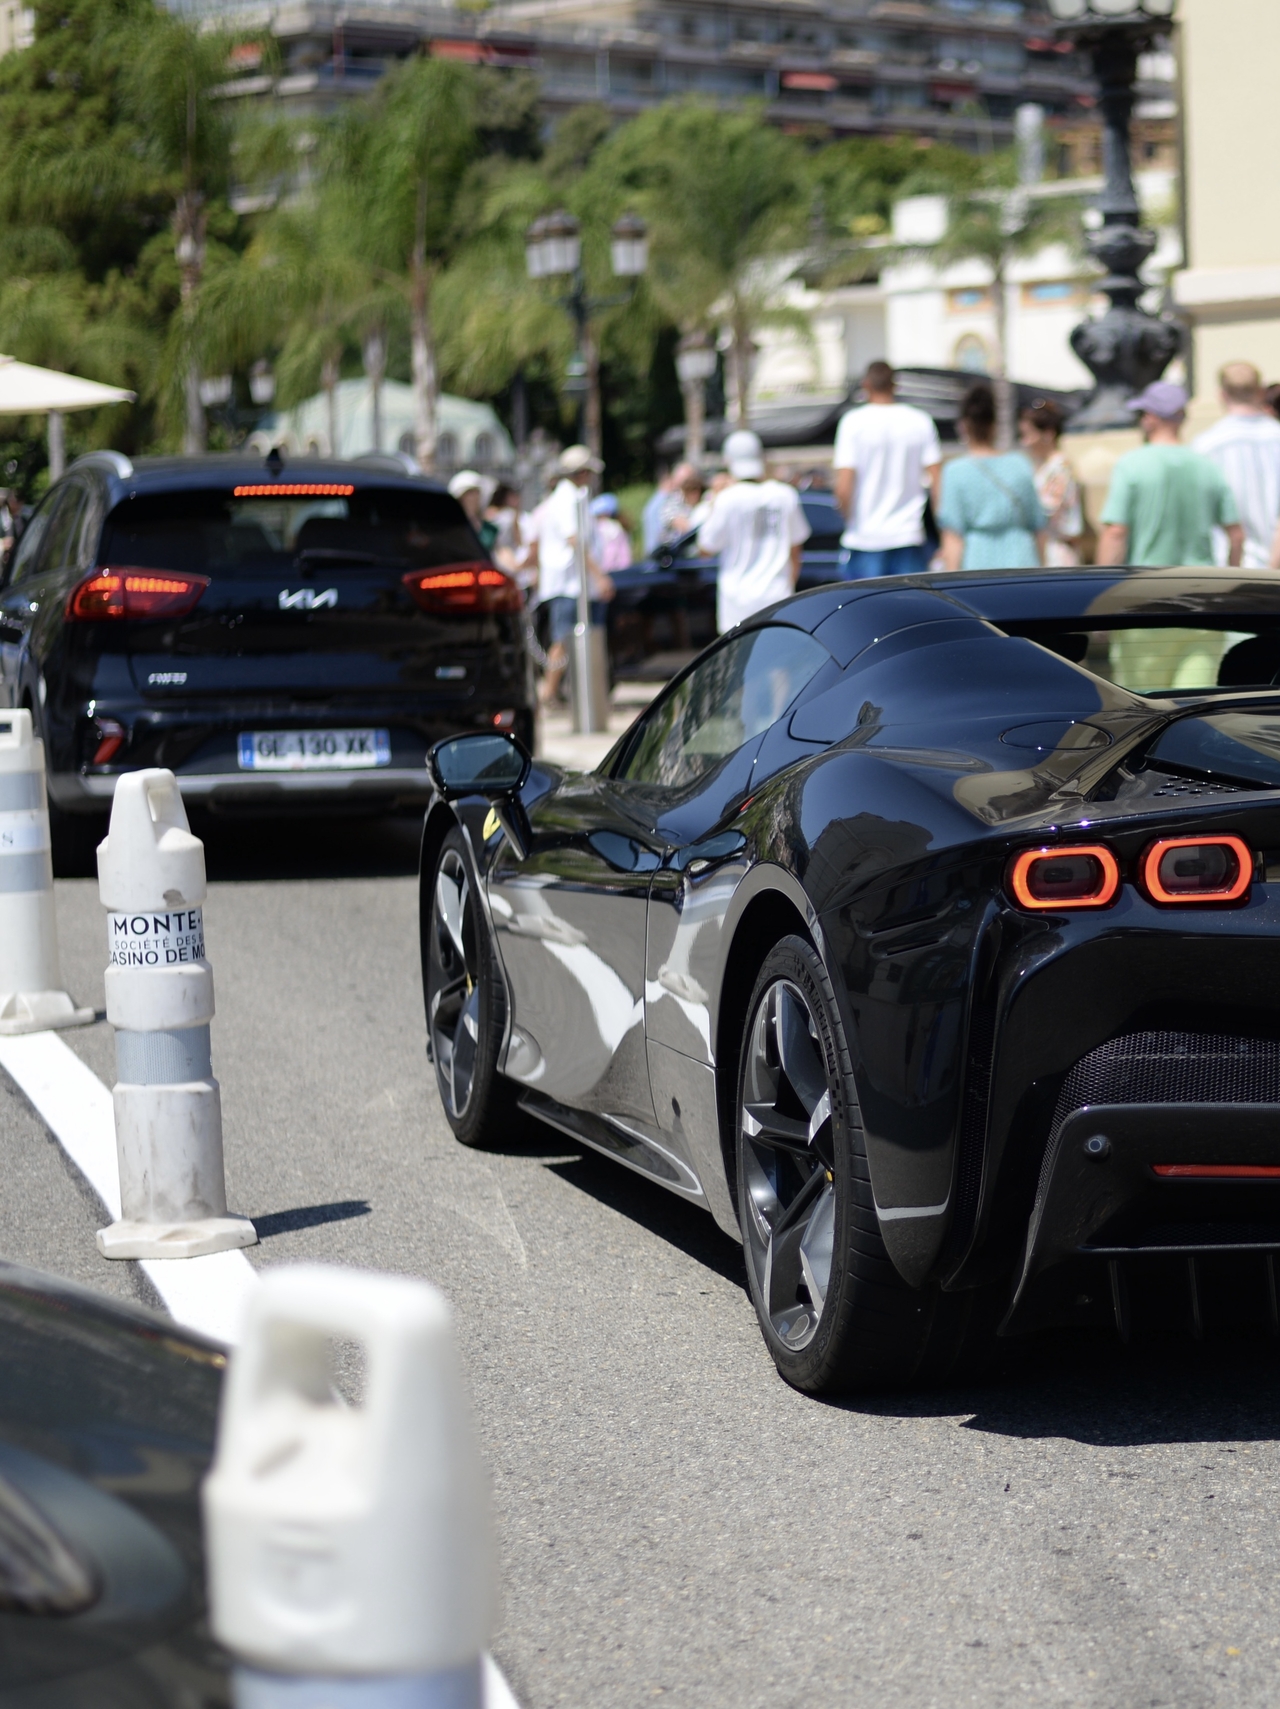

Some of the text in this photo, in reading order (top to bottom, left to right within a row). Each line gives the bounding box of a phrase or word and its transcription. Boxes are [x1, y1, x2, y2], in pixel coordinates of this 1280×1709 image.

[115, 936, 171, 951] SOCIÉTÉ
[176, 935, 198, 947] DES
[166, 947, 189, 963] DE
